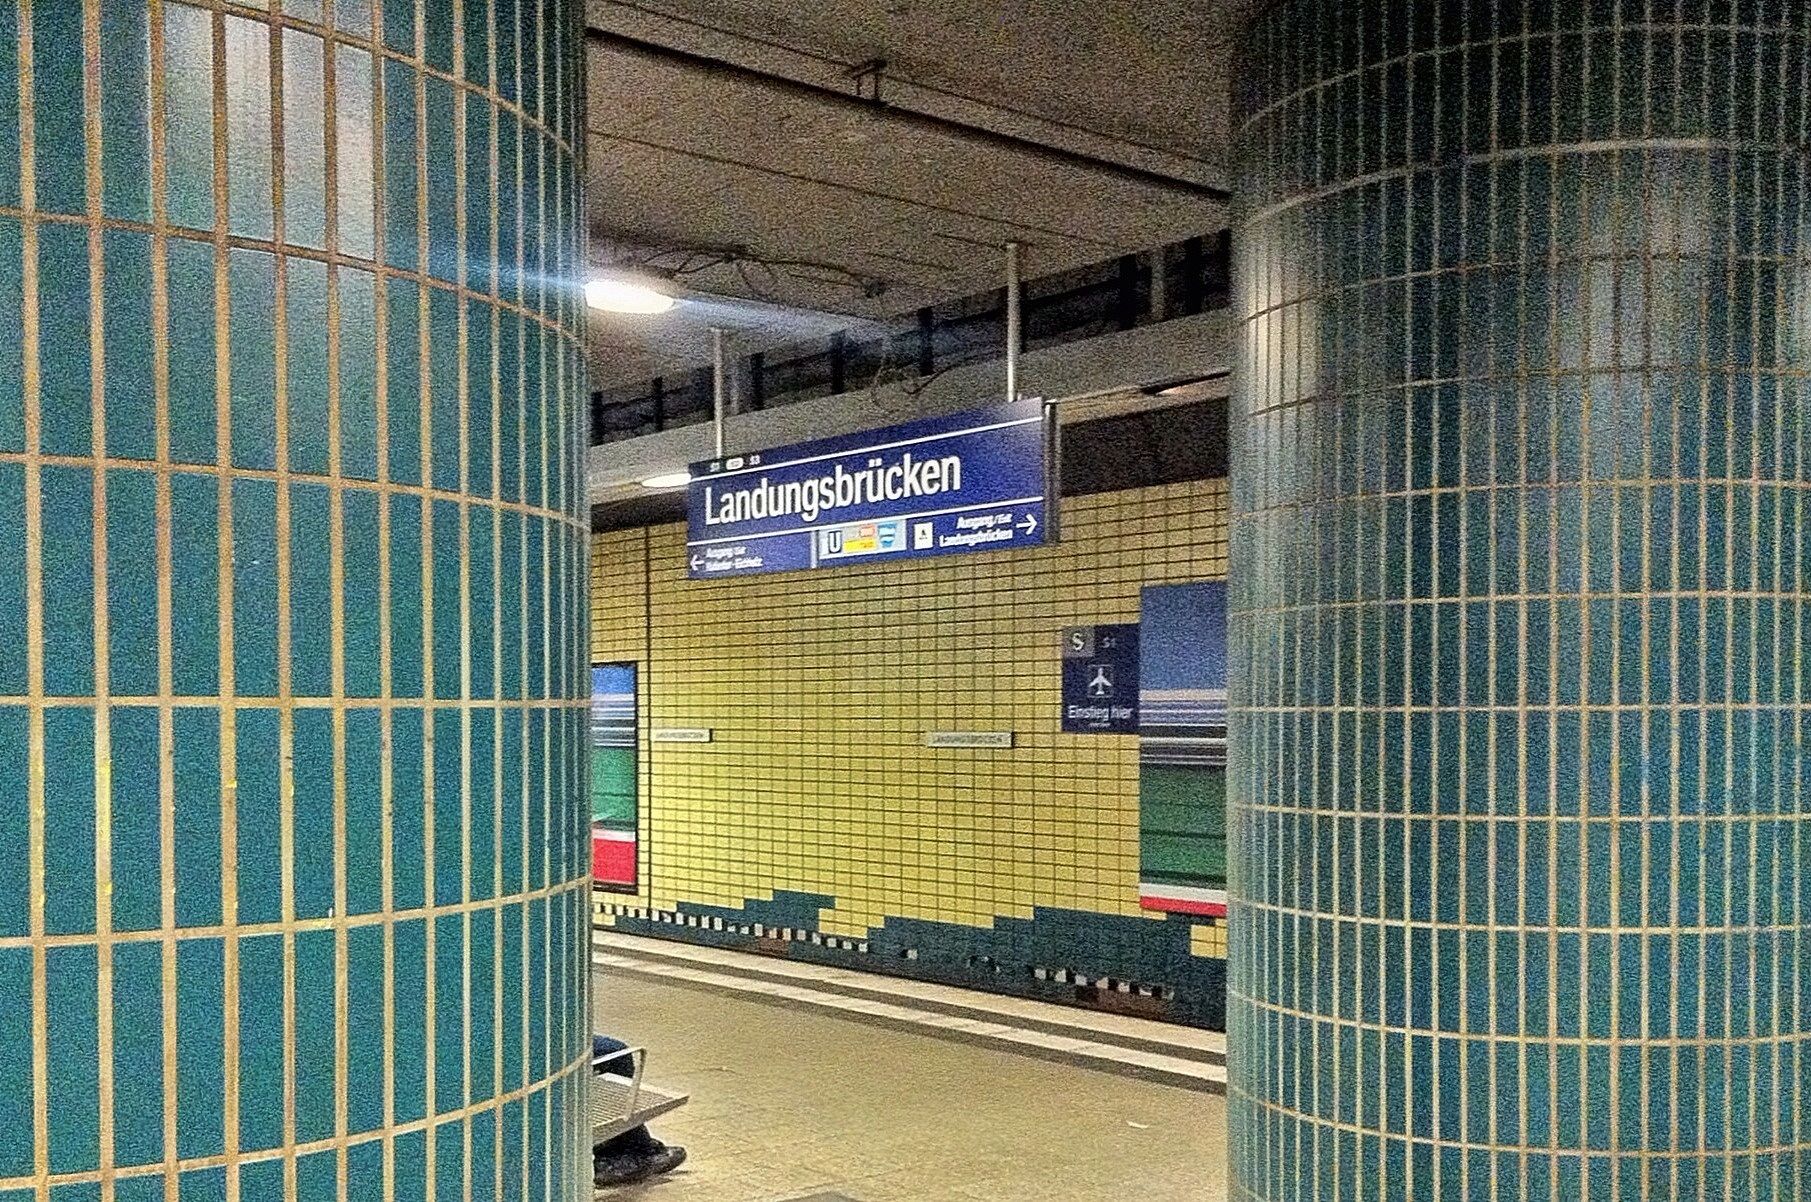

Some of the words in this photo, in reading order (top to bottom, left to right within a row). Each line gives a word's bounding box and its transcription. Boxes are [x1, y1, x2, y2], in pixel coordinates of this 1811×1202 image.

[705, 454, 961, 526] Landungsbrücken
[828, 530, 842, 554] U
[1071, 632, 1085, 651] S
[1067, 704, 1110, 722] Einstieg
